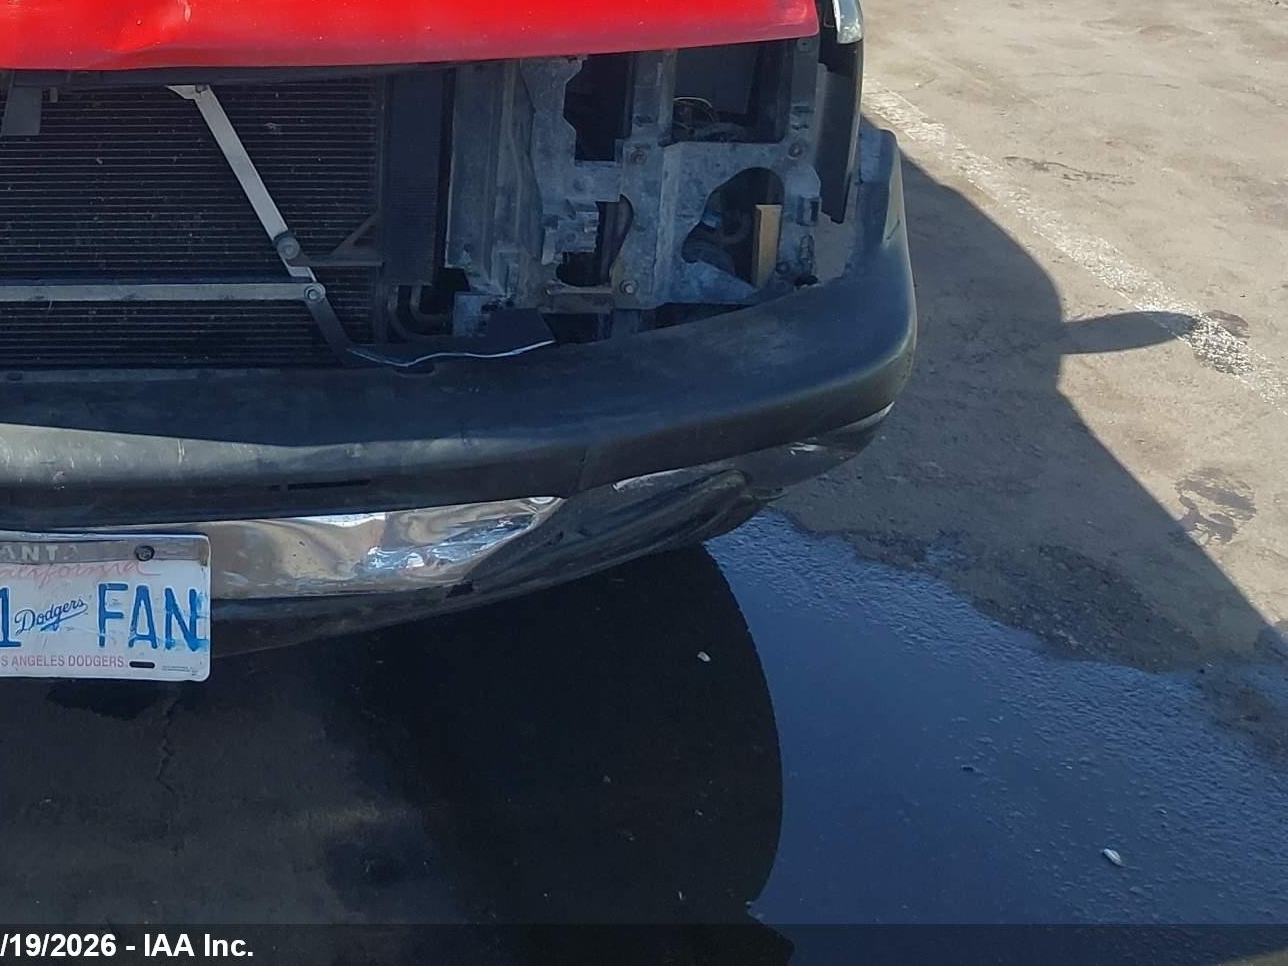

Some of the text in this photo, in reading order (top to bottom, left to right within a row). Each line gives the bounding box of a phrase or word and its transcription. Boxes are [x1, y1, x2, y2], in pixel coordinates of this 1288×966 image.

[14, 597, 88, 635] Dodgers
[98, 582, 199, 651] FAN
[11, 654, 65, 667] ANGELES
[68, 654, 125, 668] DODGERS
